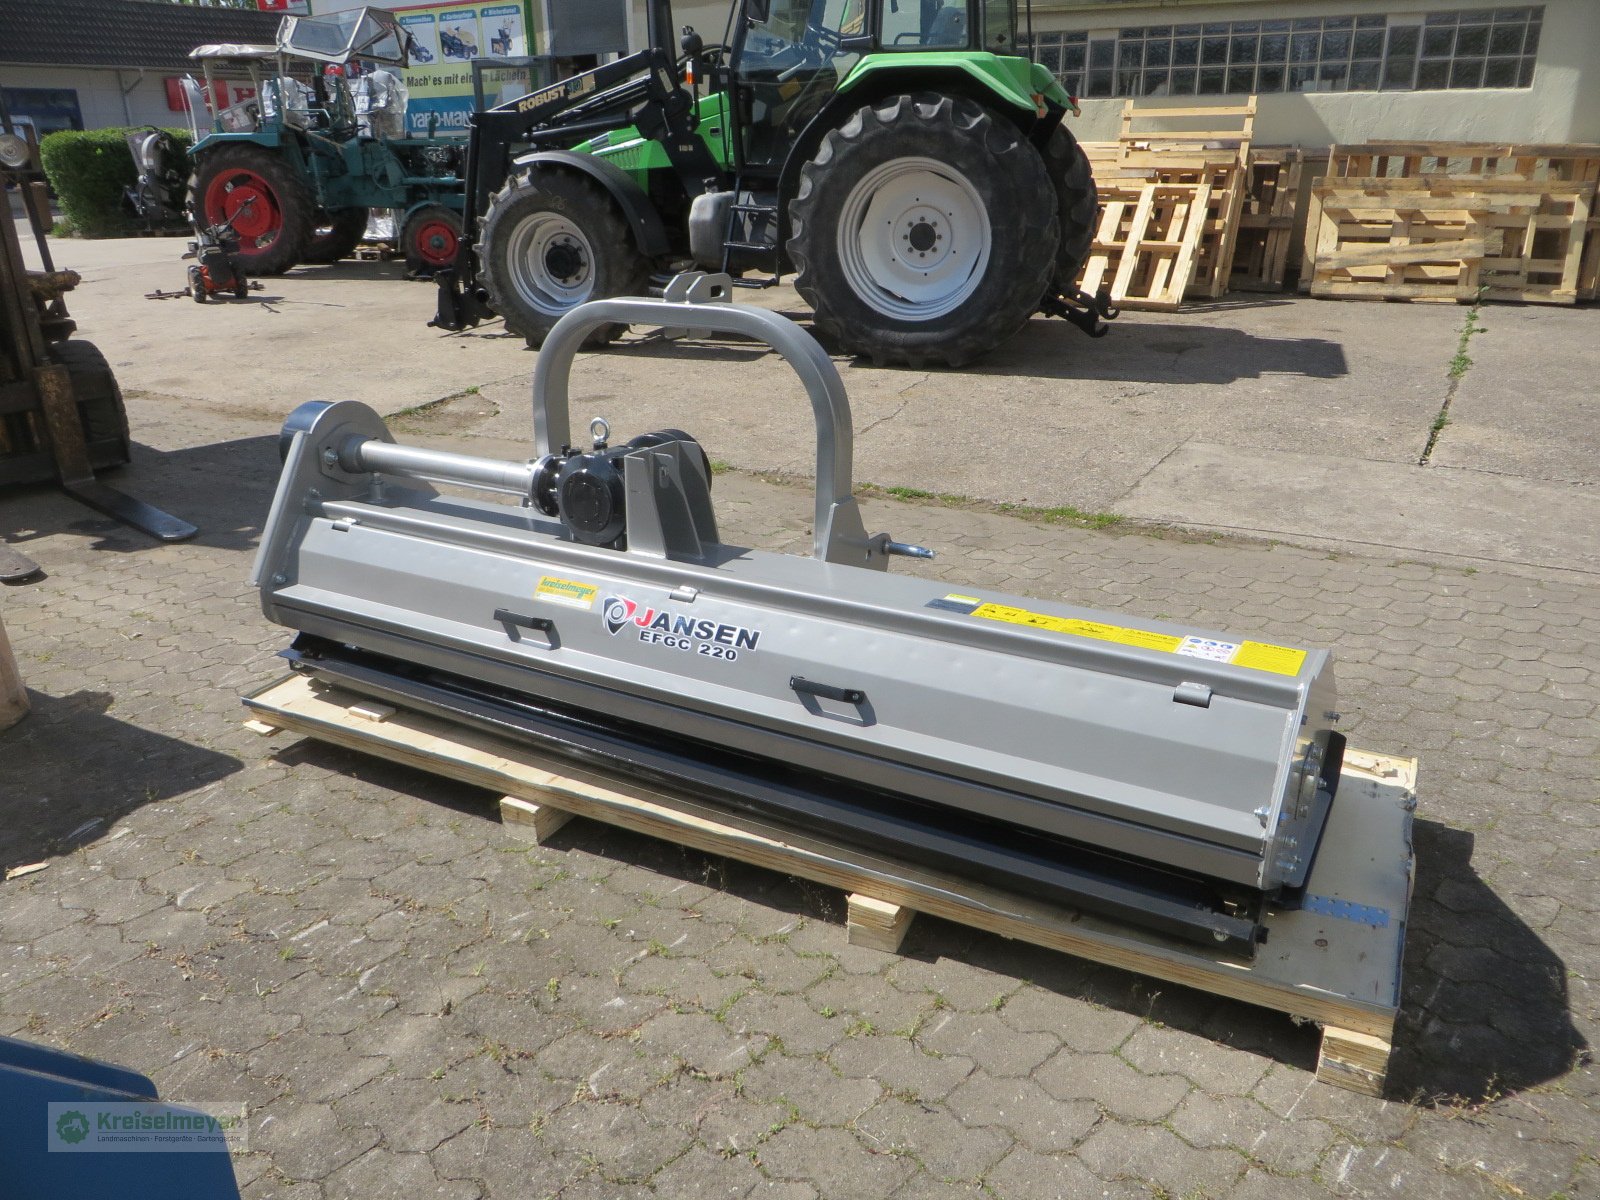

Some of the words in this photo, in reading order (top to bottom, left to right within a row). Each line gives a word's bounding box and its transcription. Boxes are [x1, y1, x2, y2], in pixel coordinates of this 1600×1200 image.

[433, 76, 442, 86] es
[444, 73, 459, 85] mit
[518, 85, 566, 113] ROBUST
[635, 609, 760, 650] JANSEN
[640, 631, 690, 650] EFGC
[699, 644, 737, 660] 220
